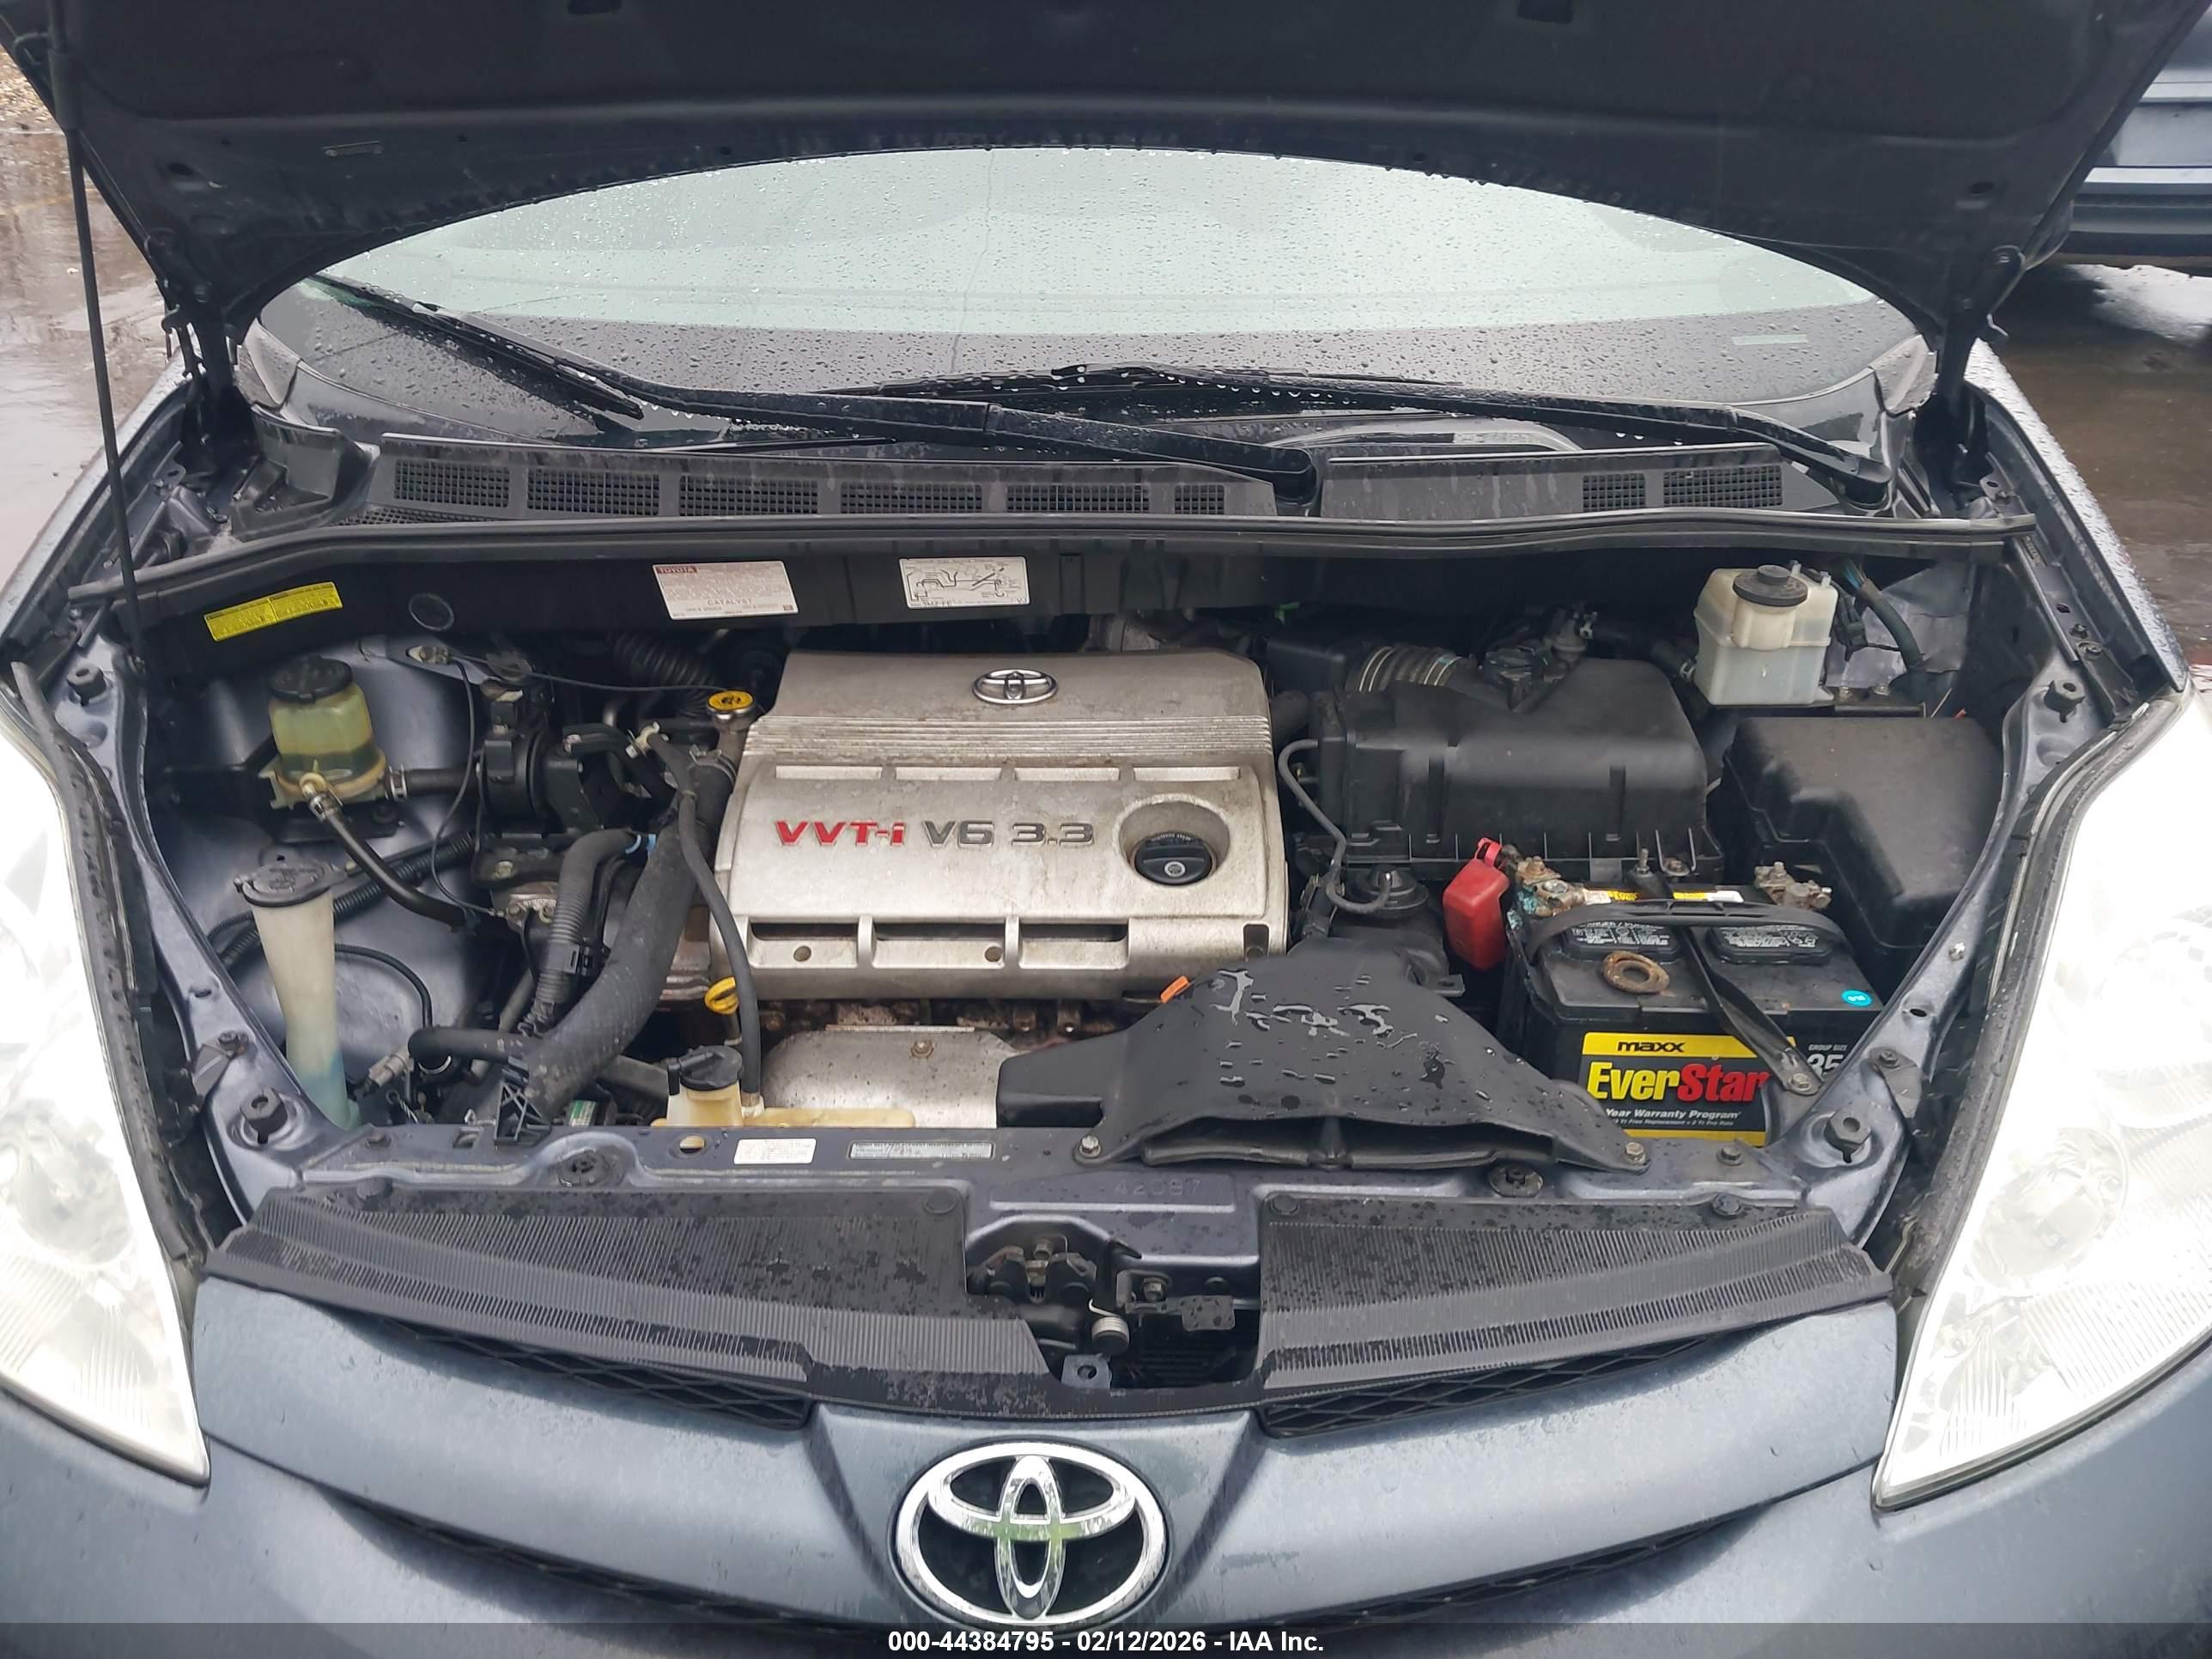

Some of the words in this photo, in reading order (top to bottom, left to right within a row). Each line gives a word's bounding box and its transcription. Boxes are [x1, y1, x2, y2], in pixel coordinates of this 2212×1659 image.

[775, 820, 905, 846] VVT-i
[923, 820, 994, 846] V6
[1010, 821, 1095, 846] 3.3
[1617, 1042, 1686, 1053] maxx
[1587, 1061, 1771, 1103] EverStar
[1634, 1109, 1687, 1119] Warranty
